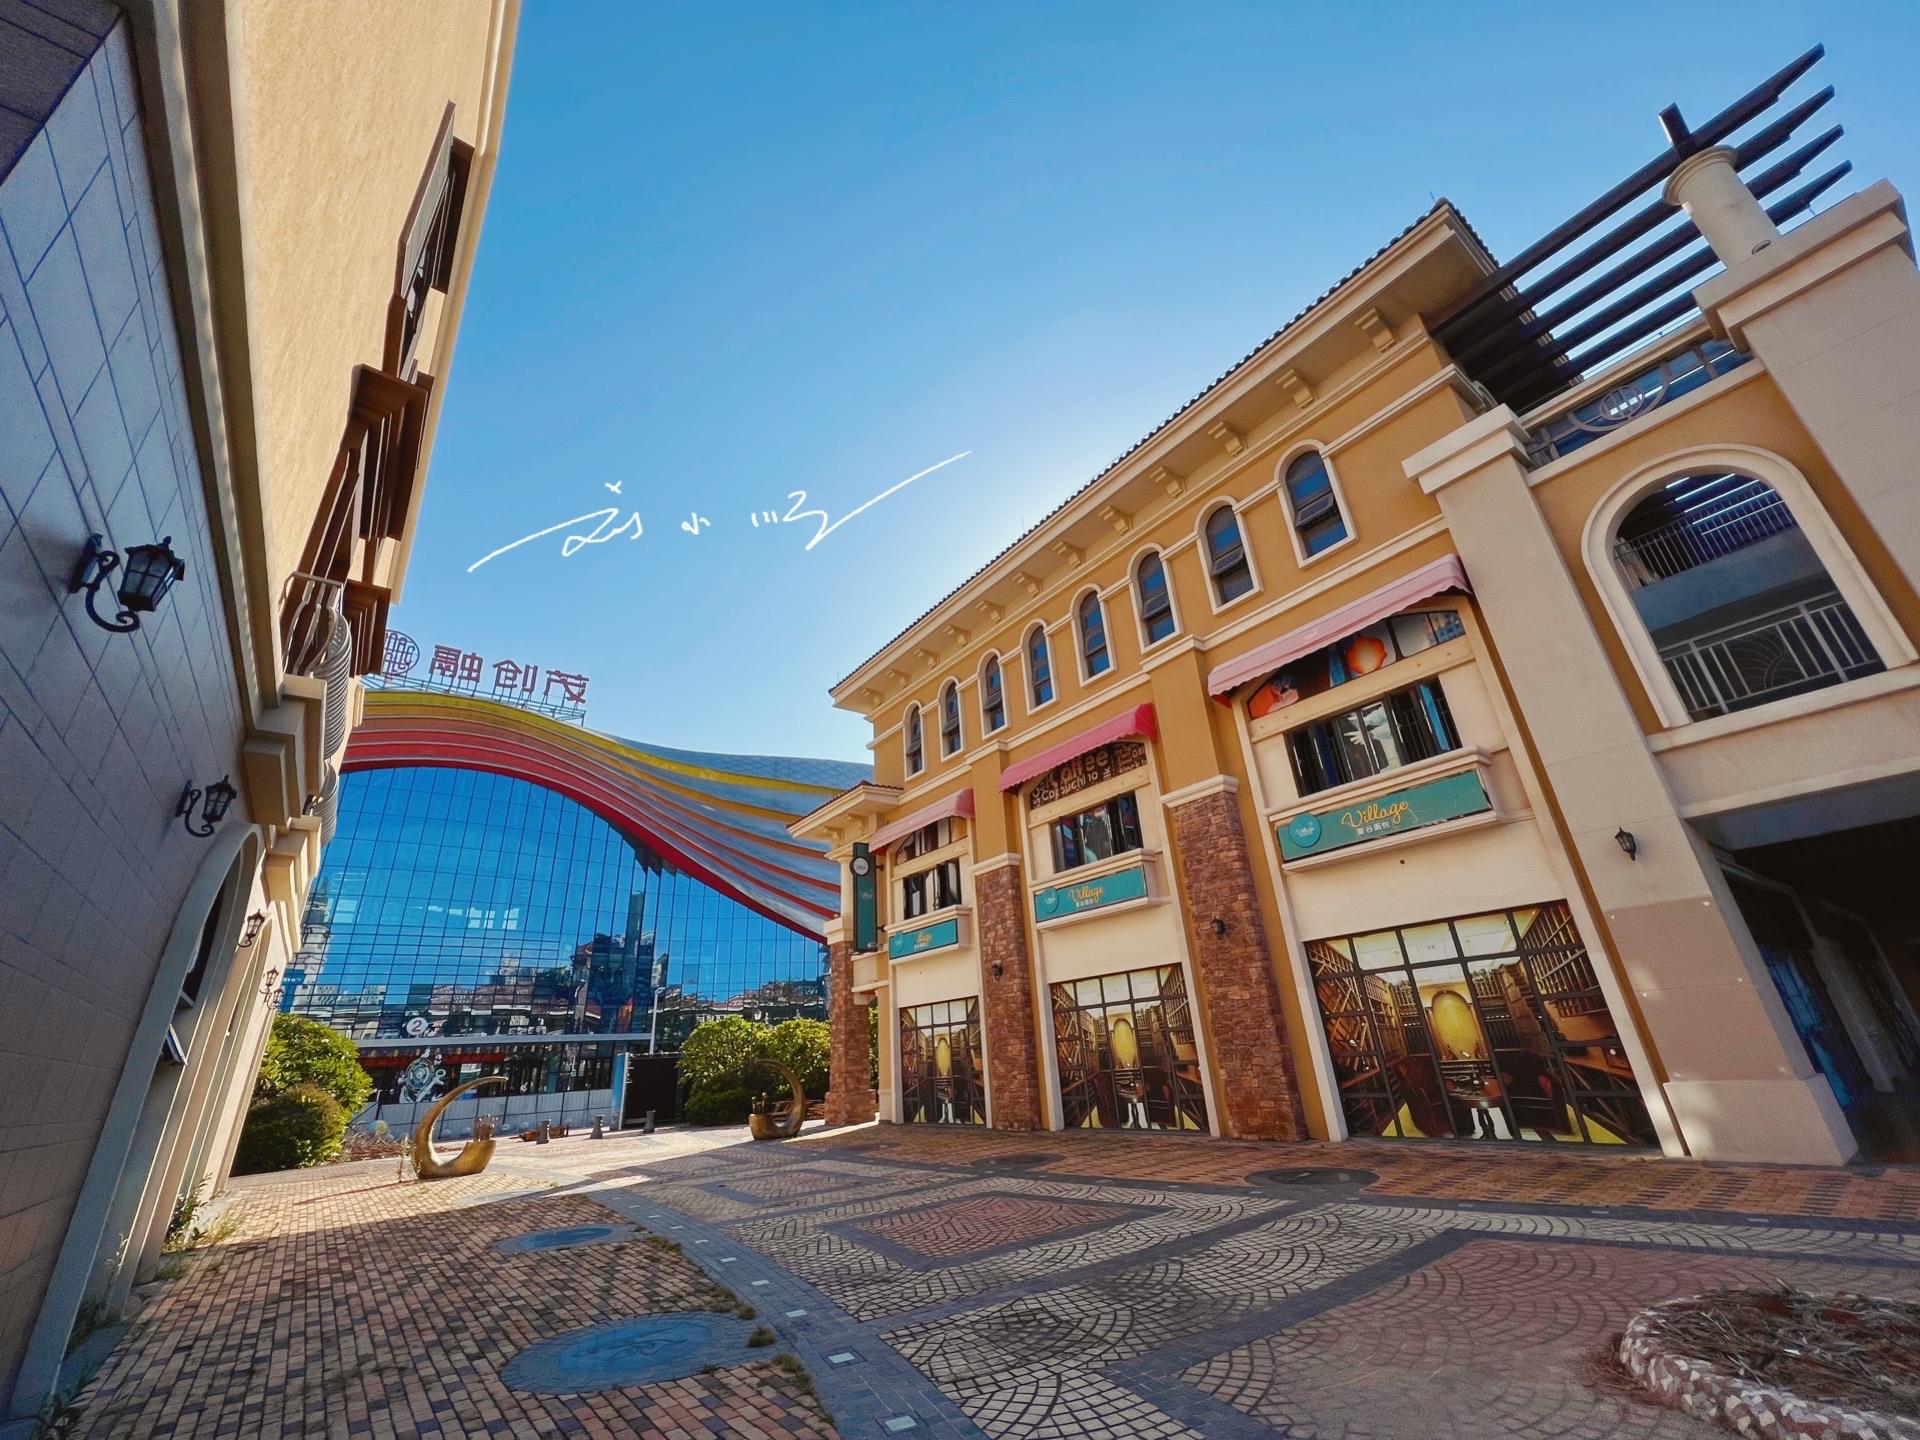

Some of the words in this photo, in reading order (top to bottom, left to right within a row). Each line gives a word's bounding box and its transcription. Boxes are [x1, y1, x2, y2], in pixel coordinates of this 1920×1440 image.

[429, 644, 589, 703] 融创茂
[1341, 800, 1408, 828] Village
[411, 1020, 422, 1032] 2
